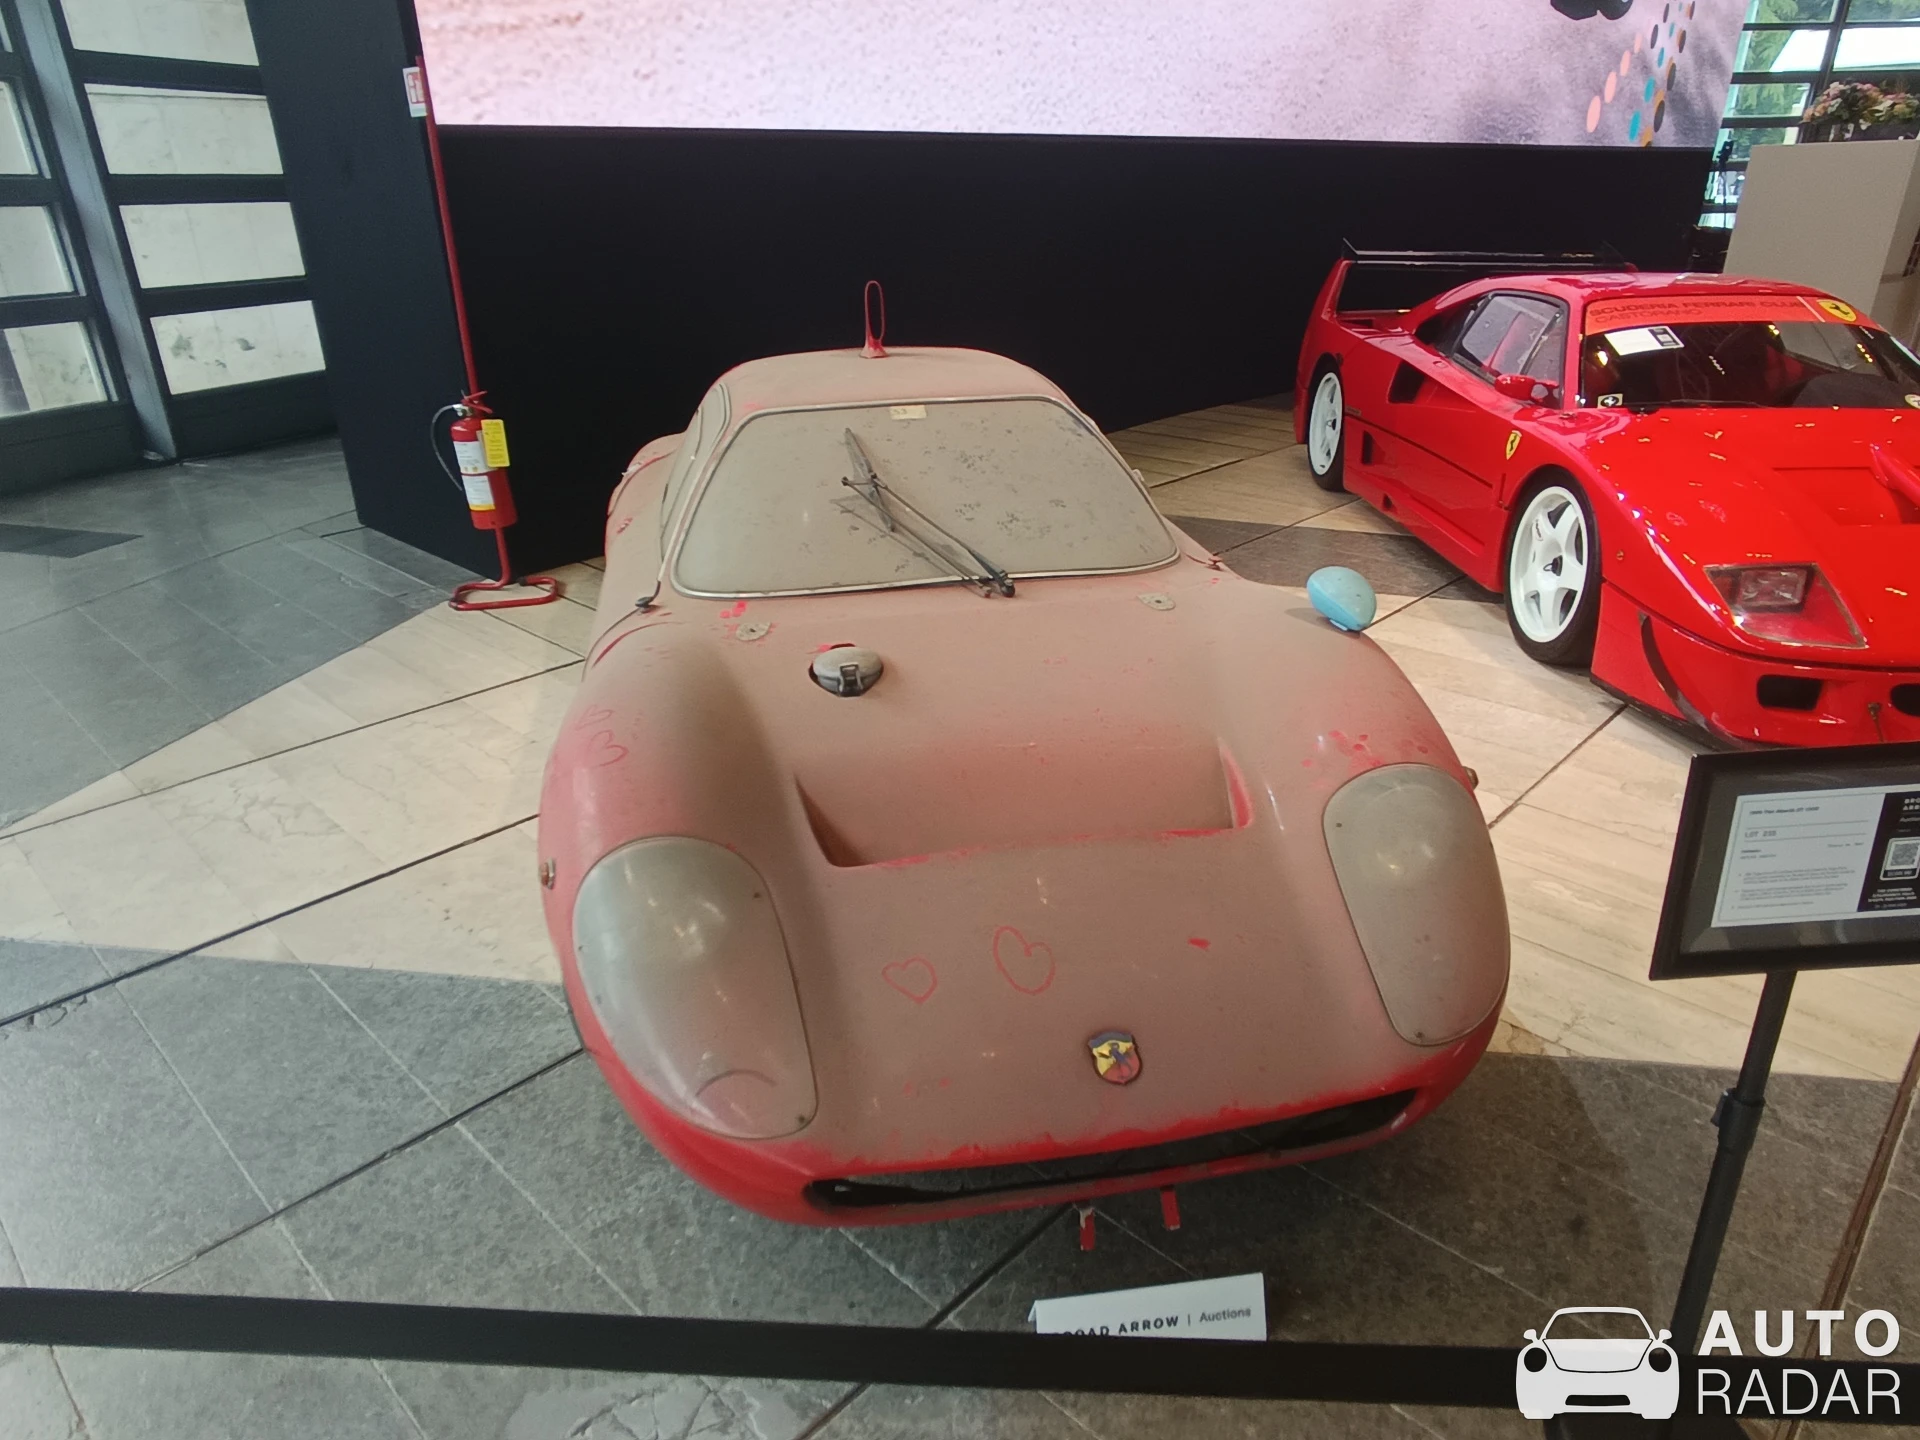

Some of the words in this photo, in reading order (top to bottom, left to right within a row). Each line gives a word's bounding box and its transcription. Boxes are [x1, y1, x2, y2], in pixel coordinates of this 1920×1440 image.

[1589, 302, 1679, 316] SCUDERIA
[1682, 301, 1757, 309] FERRARI
[1118, 1315, 1179, 1335] ARROW
[1199, 1308, 1252, 1323] Auctions
